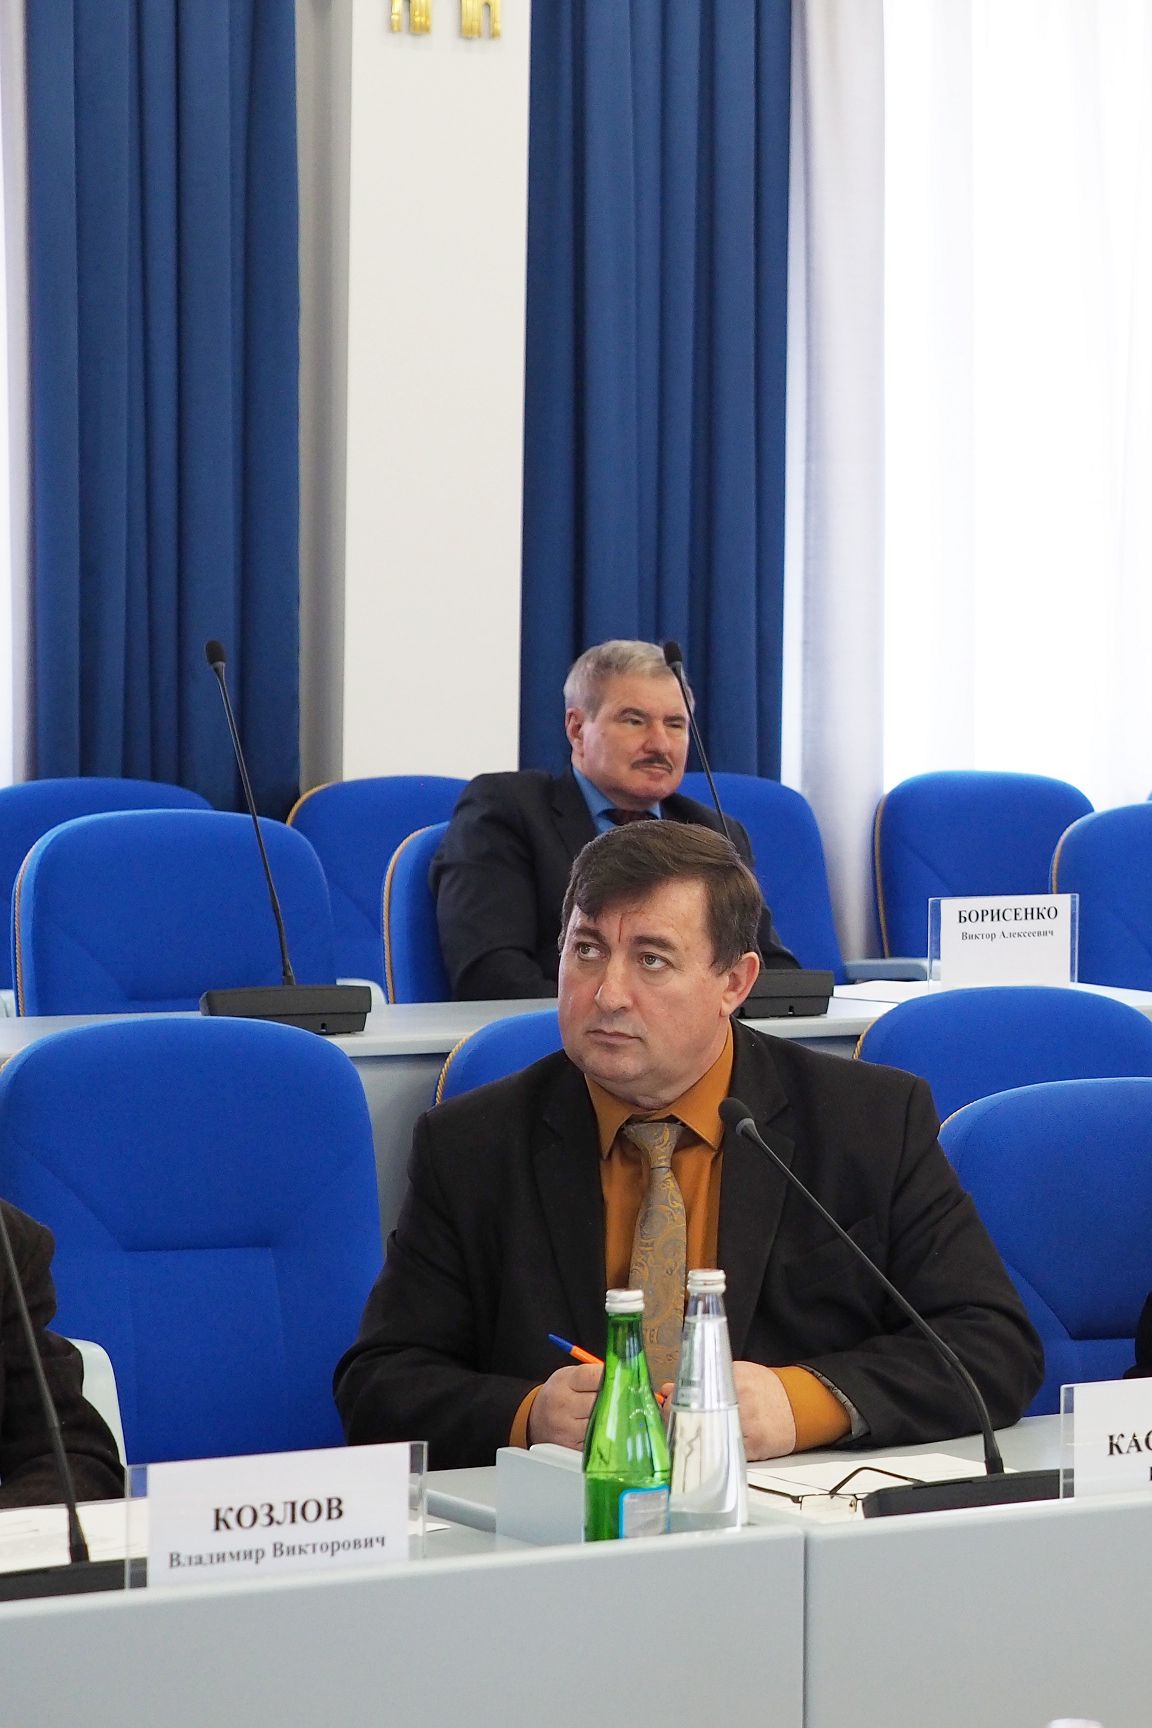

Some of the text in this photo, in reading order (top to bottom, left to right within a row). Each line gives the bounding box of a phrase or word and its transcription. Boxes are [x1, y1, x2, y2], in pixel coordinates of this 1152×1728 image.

[958, 906, 1058, 924] БОРИСЕНКО
[961, 928, 1054, 942] Виктор Алексеевич
[213, 1497, 344, 1532] КОЗЛОВ
[168, 1536, 385, 1569] Владимир Викторович
